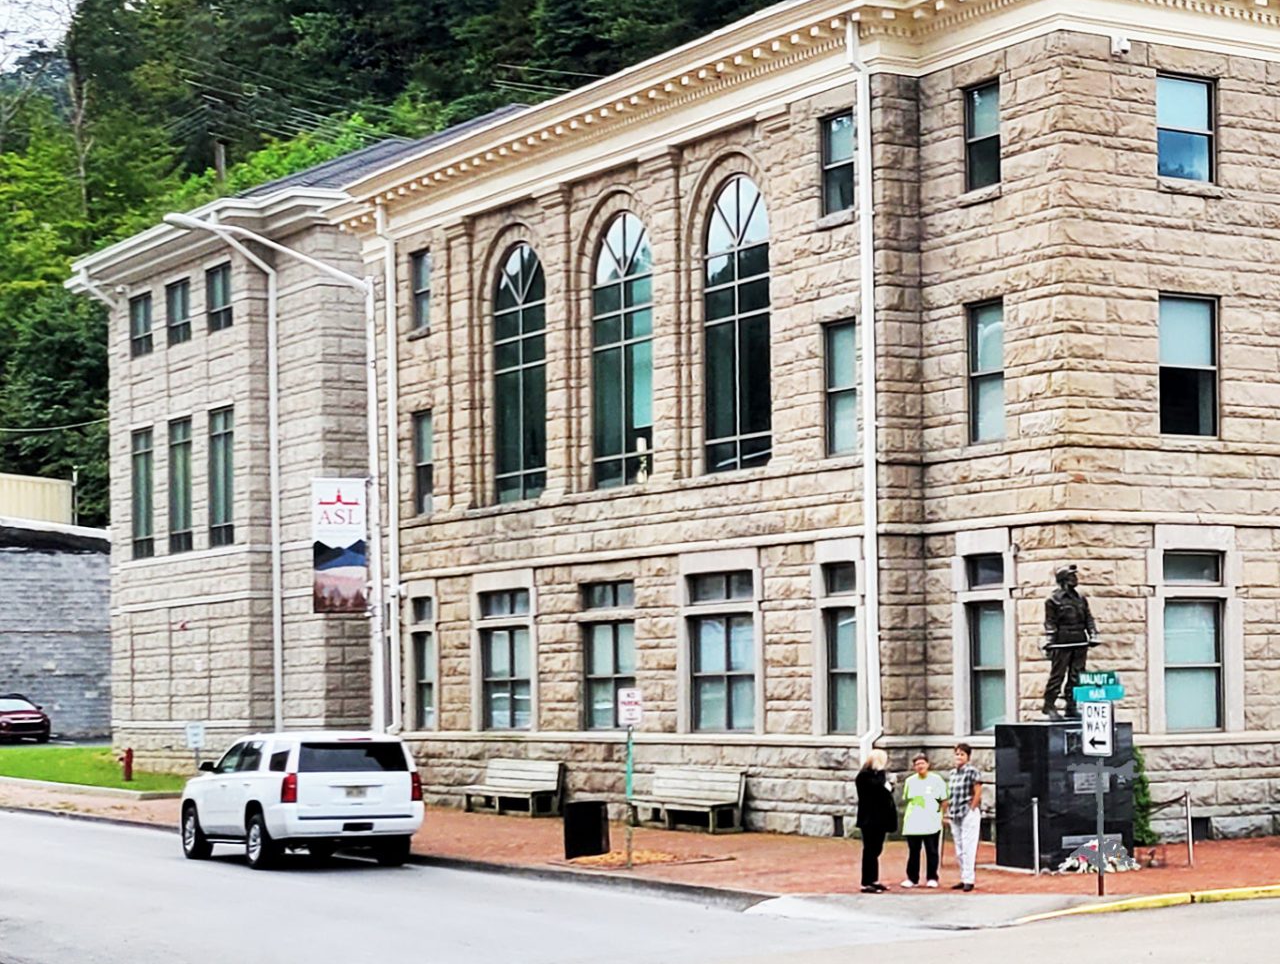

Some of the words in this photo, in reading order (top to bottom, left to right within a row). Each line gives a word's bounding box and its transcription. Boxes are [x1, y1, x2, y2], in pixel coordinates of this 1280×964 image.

[317, 508, 361, 525] ASL
[1079, 672, 1109, 686] WALNUT
[1086, 705, 1108, 718] ONE
[1086, 720, 1108, 733] WAY
